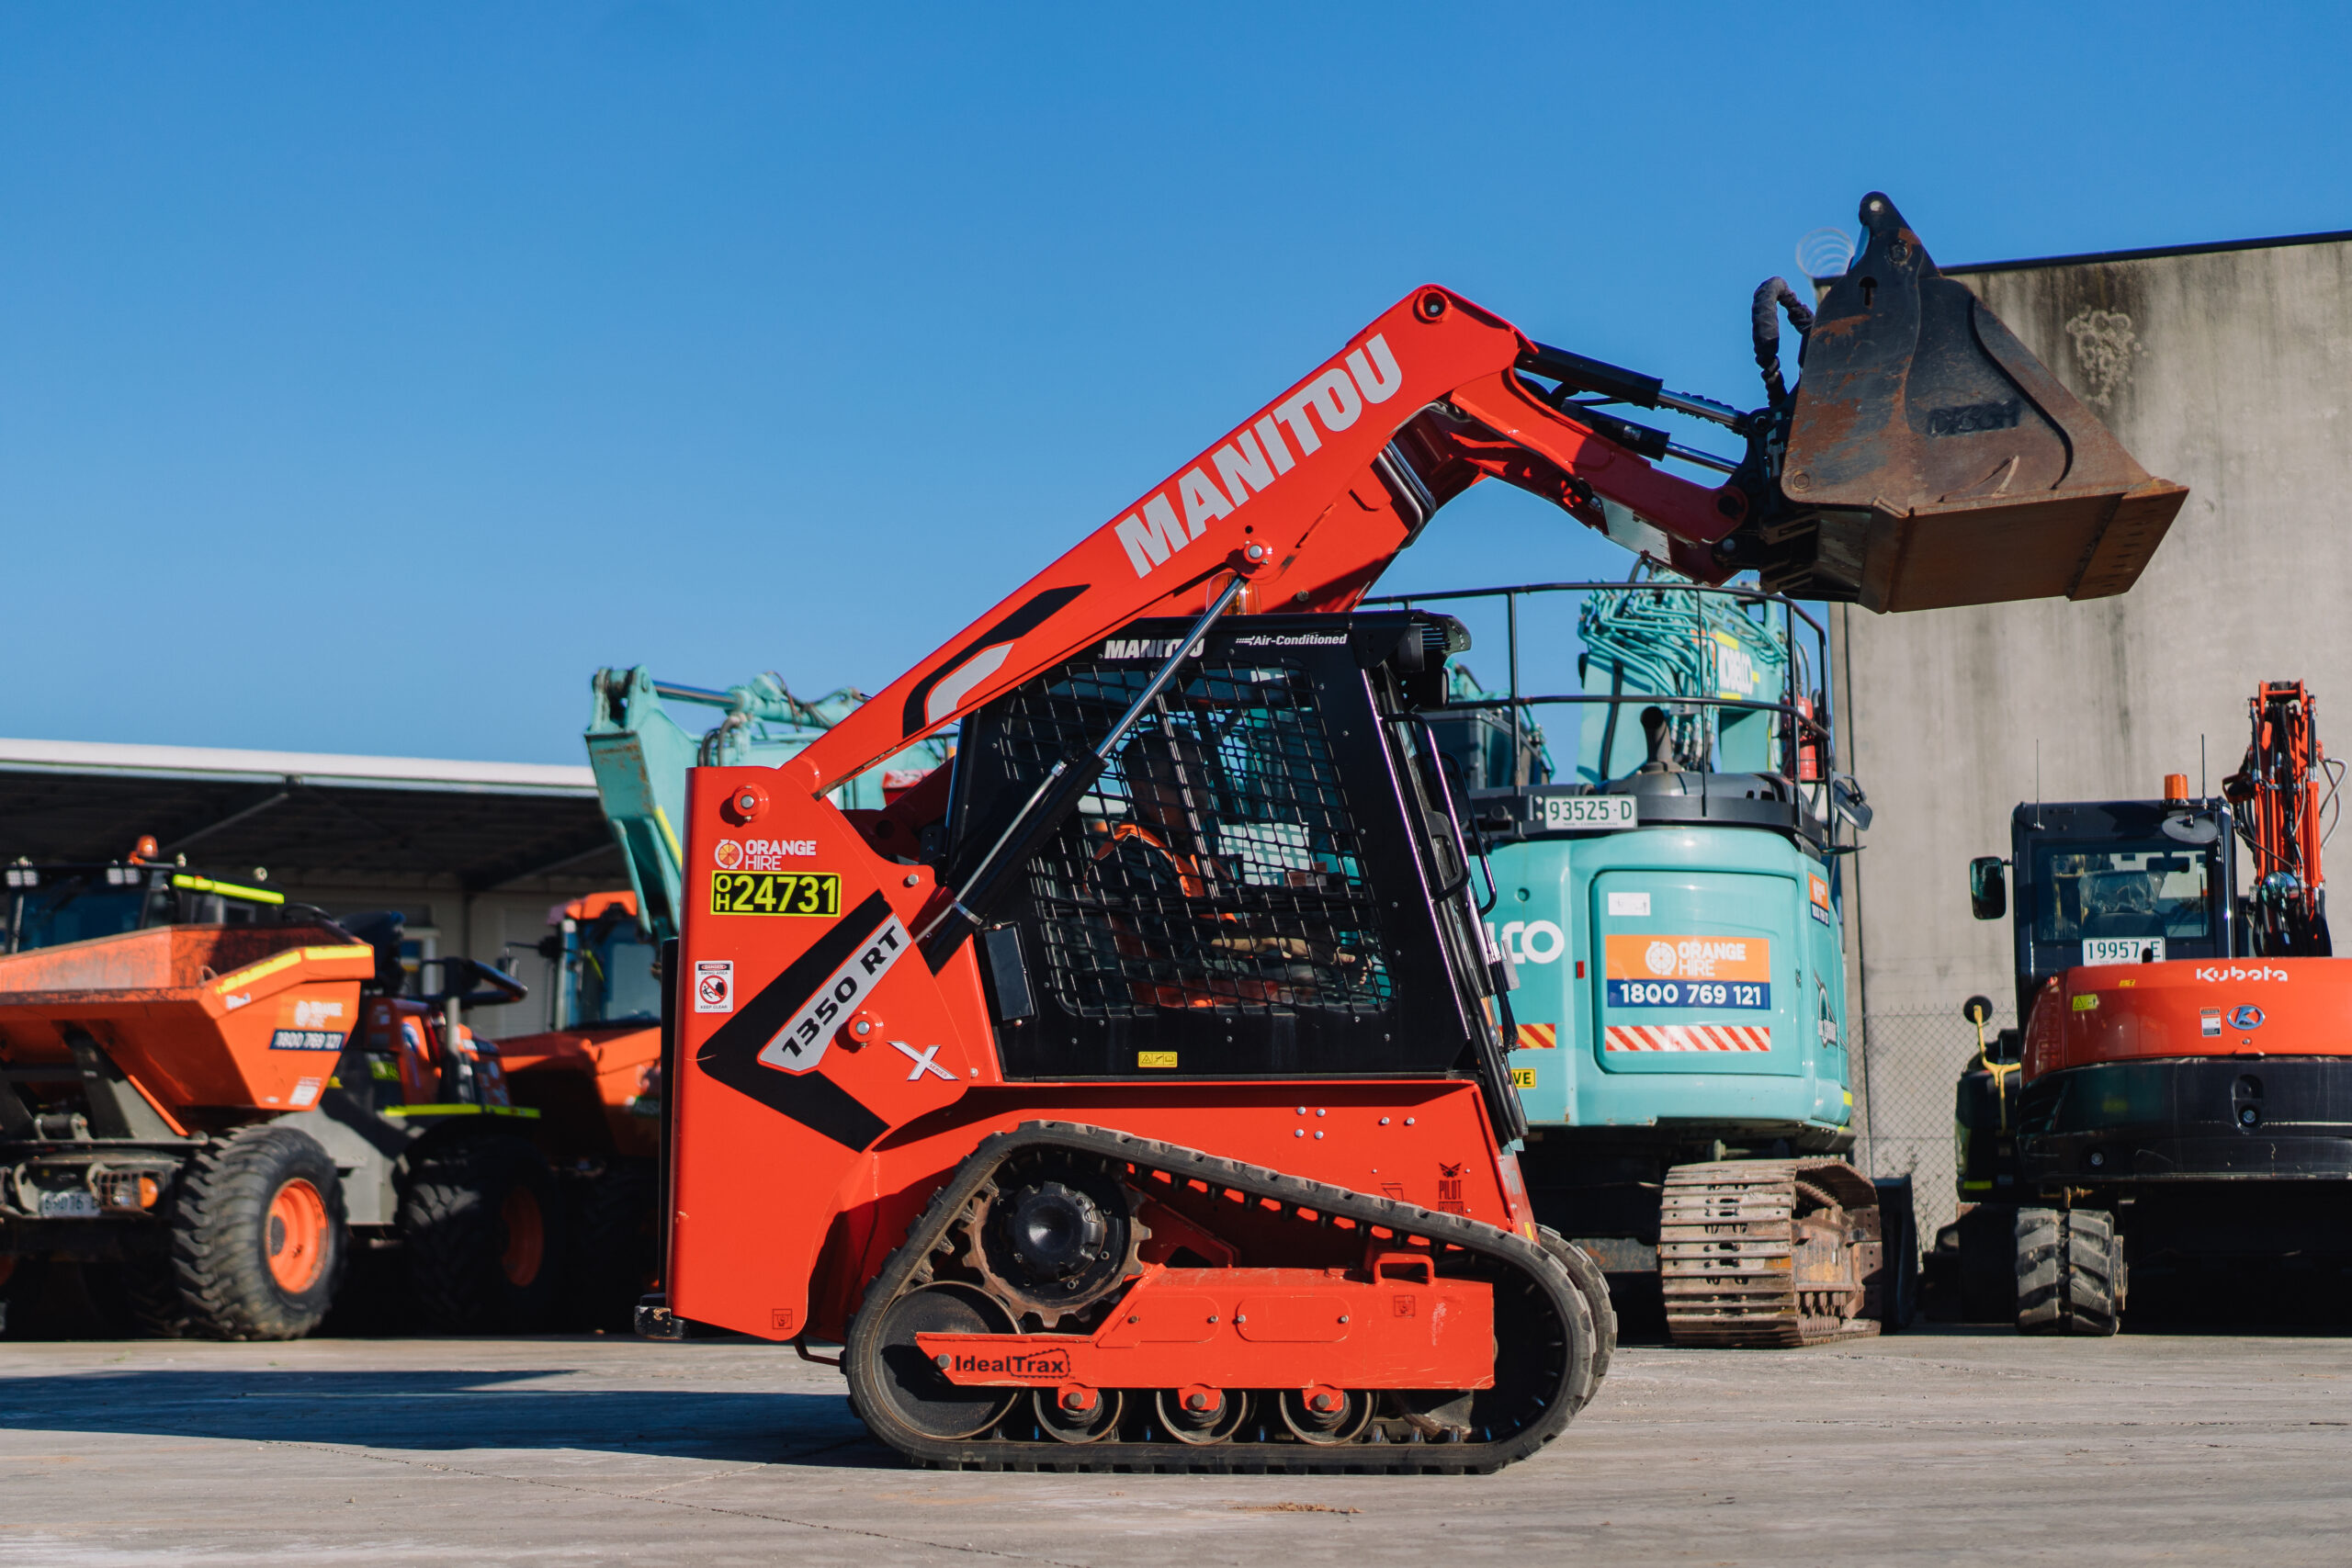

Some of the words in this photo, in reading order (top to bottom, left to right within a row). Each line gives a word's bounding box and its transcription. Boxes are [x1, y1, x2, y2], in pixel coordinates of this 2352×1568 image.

[1114, 333, 1402, 579] MANITOU
[1253, 634, 1348, 645] Air-Conditioned
[745, 840, 817, 856] ORANGE
[745, 855, 782, 871] HIRE
[732, 875, 836, 913] 24731
[1678, 941, 1746, 961] ORANGE
[2088, 942, 2139, 959] 19957
[1678, 958, 1715, 976] HIRE
[2196, 965, 2288, 982] Kubota
[782, 976, 858, 1058] 1350
[860, 925, 900, 976] RT
[1620, 983, 1679, 1003] 1800
[1686, 984, 1726, 1005] 769
[1733, 985, 1761, 1006] 121
[887, 1041, 959, 1081] X
[929, 1063, 948, 1077] SERIES
[1439, 1179, 1463, 1200] PILOT
[956, 1355, 1064, 1373] IdealTrax
